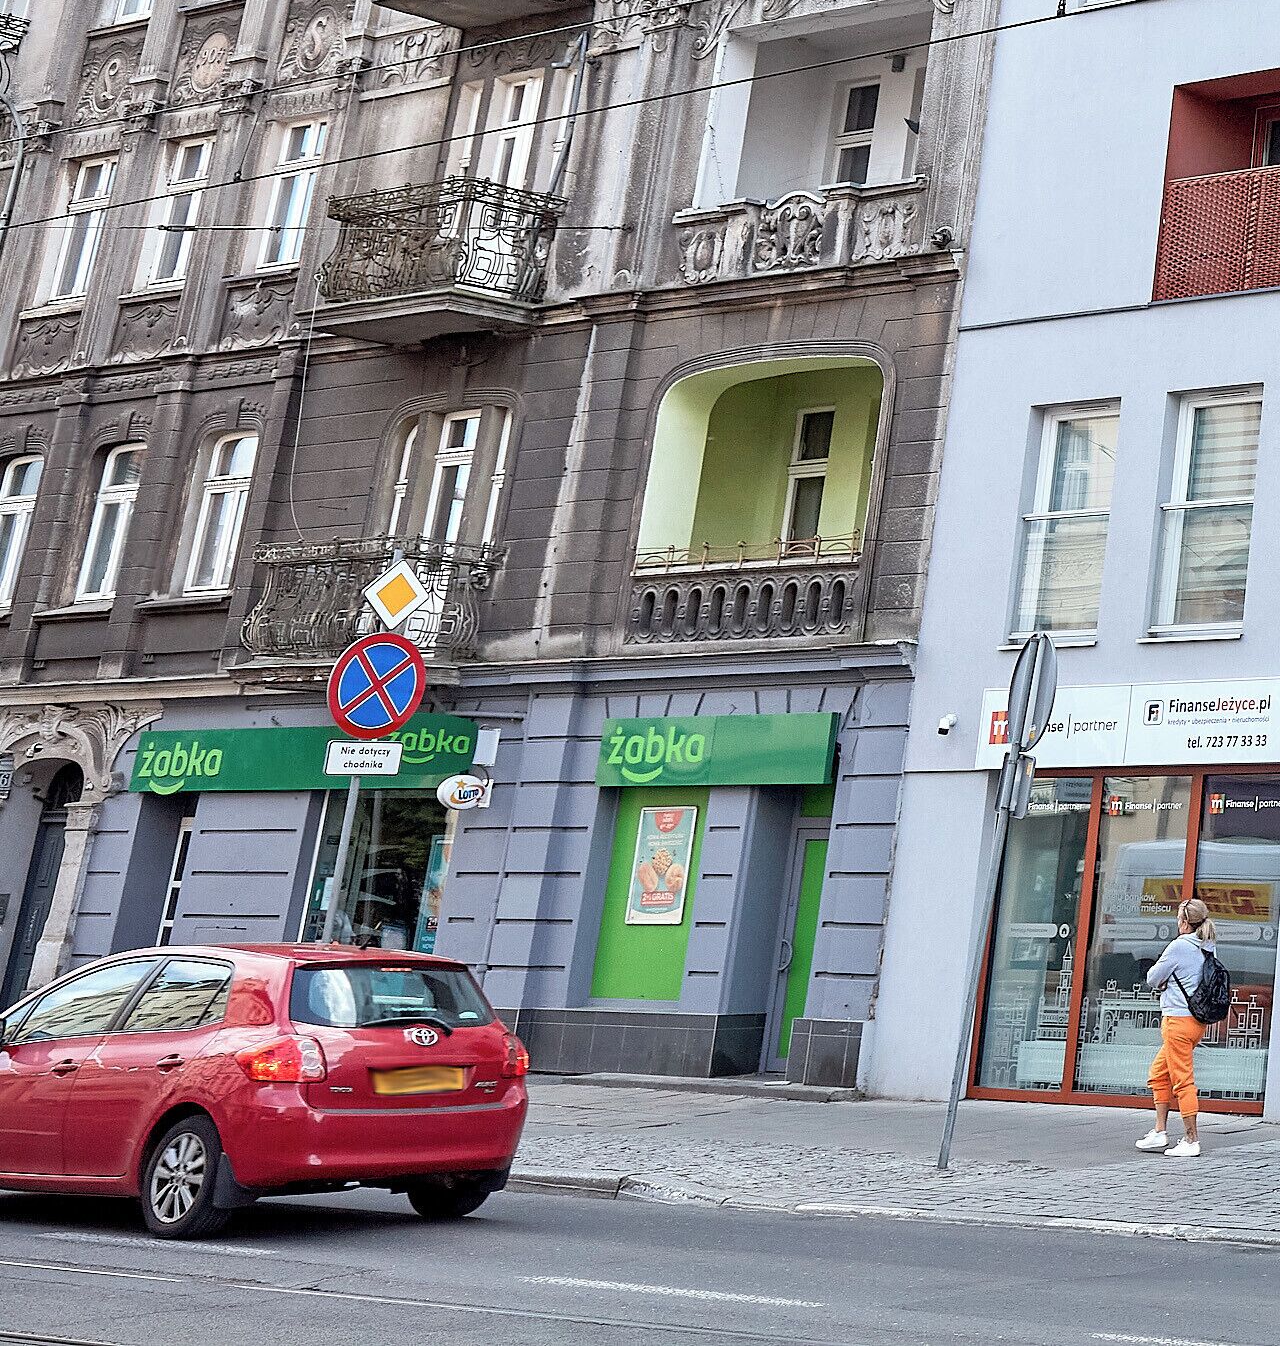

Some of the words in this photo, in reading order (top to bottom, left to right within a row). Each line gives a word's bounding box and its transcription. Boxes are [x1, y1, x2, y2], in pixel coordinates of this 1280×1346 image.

[1169, 694, 1271, 714] FinanseJeżyce.pl
[1073, 720, 1118, 734] partner
[607, 726, 706, 764] żabka
[1187, 736, 1202, 748] tel.
[1206, 736, 1224, 748] 723
[1226, 735, 1239, 747] 77
[1240, 735, 1253, 746] 33
[1255, 735, 1267, 746] 33
[340, 746, 356, 755] Nie
[358, 746, 391, 757] dotyczy
[137, 742, 223, 777] żabka
[343, 760, 383, 768] chodnika
[1125, 801, 1152, 809] Finanse
[1156, 801, 1183, 810] partner
[1225, 800, 1254, 808] Finanse
[1140, 904, 1171, 914] miejscu
